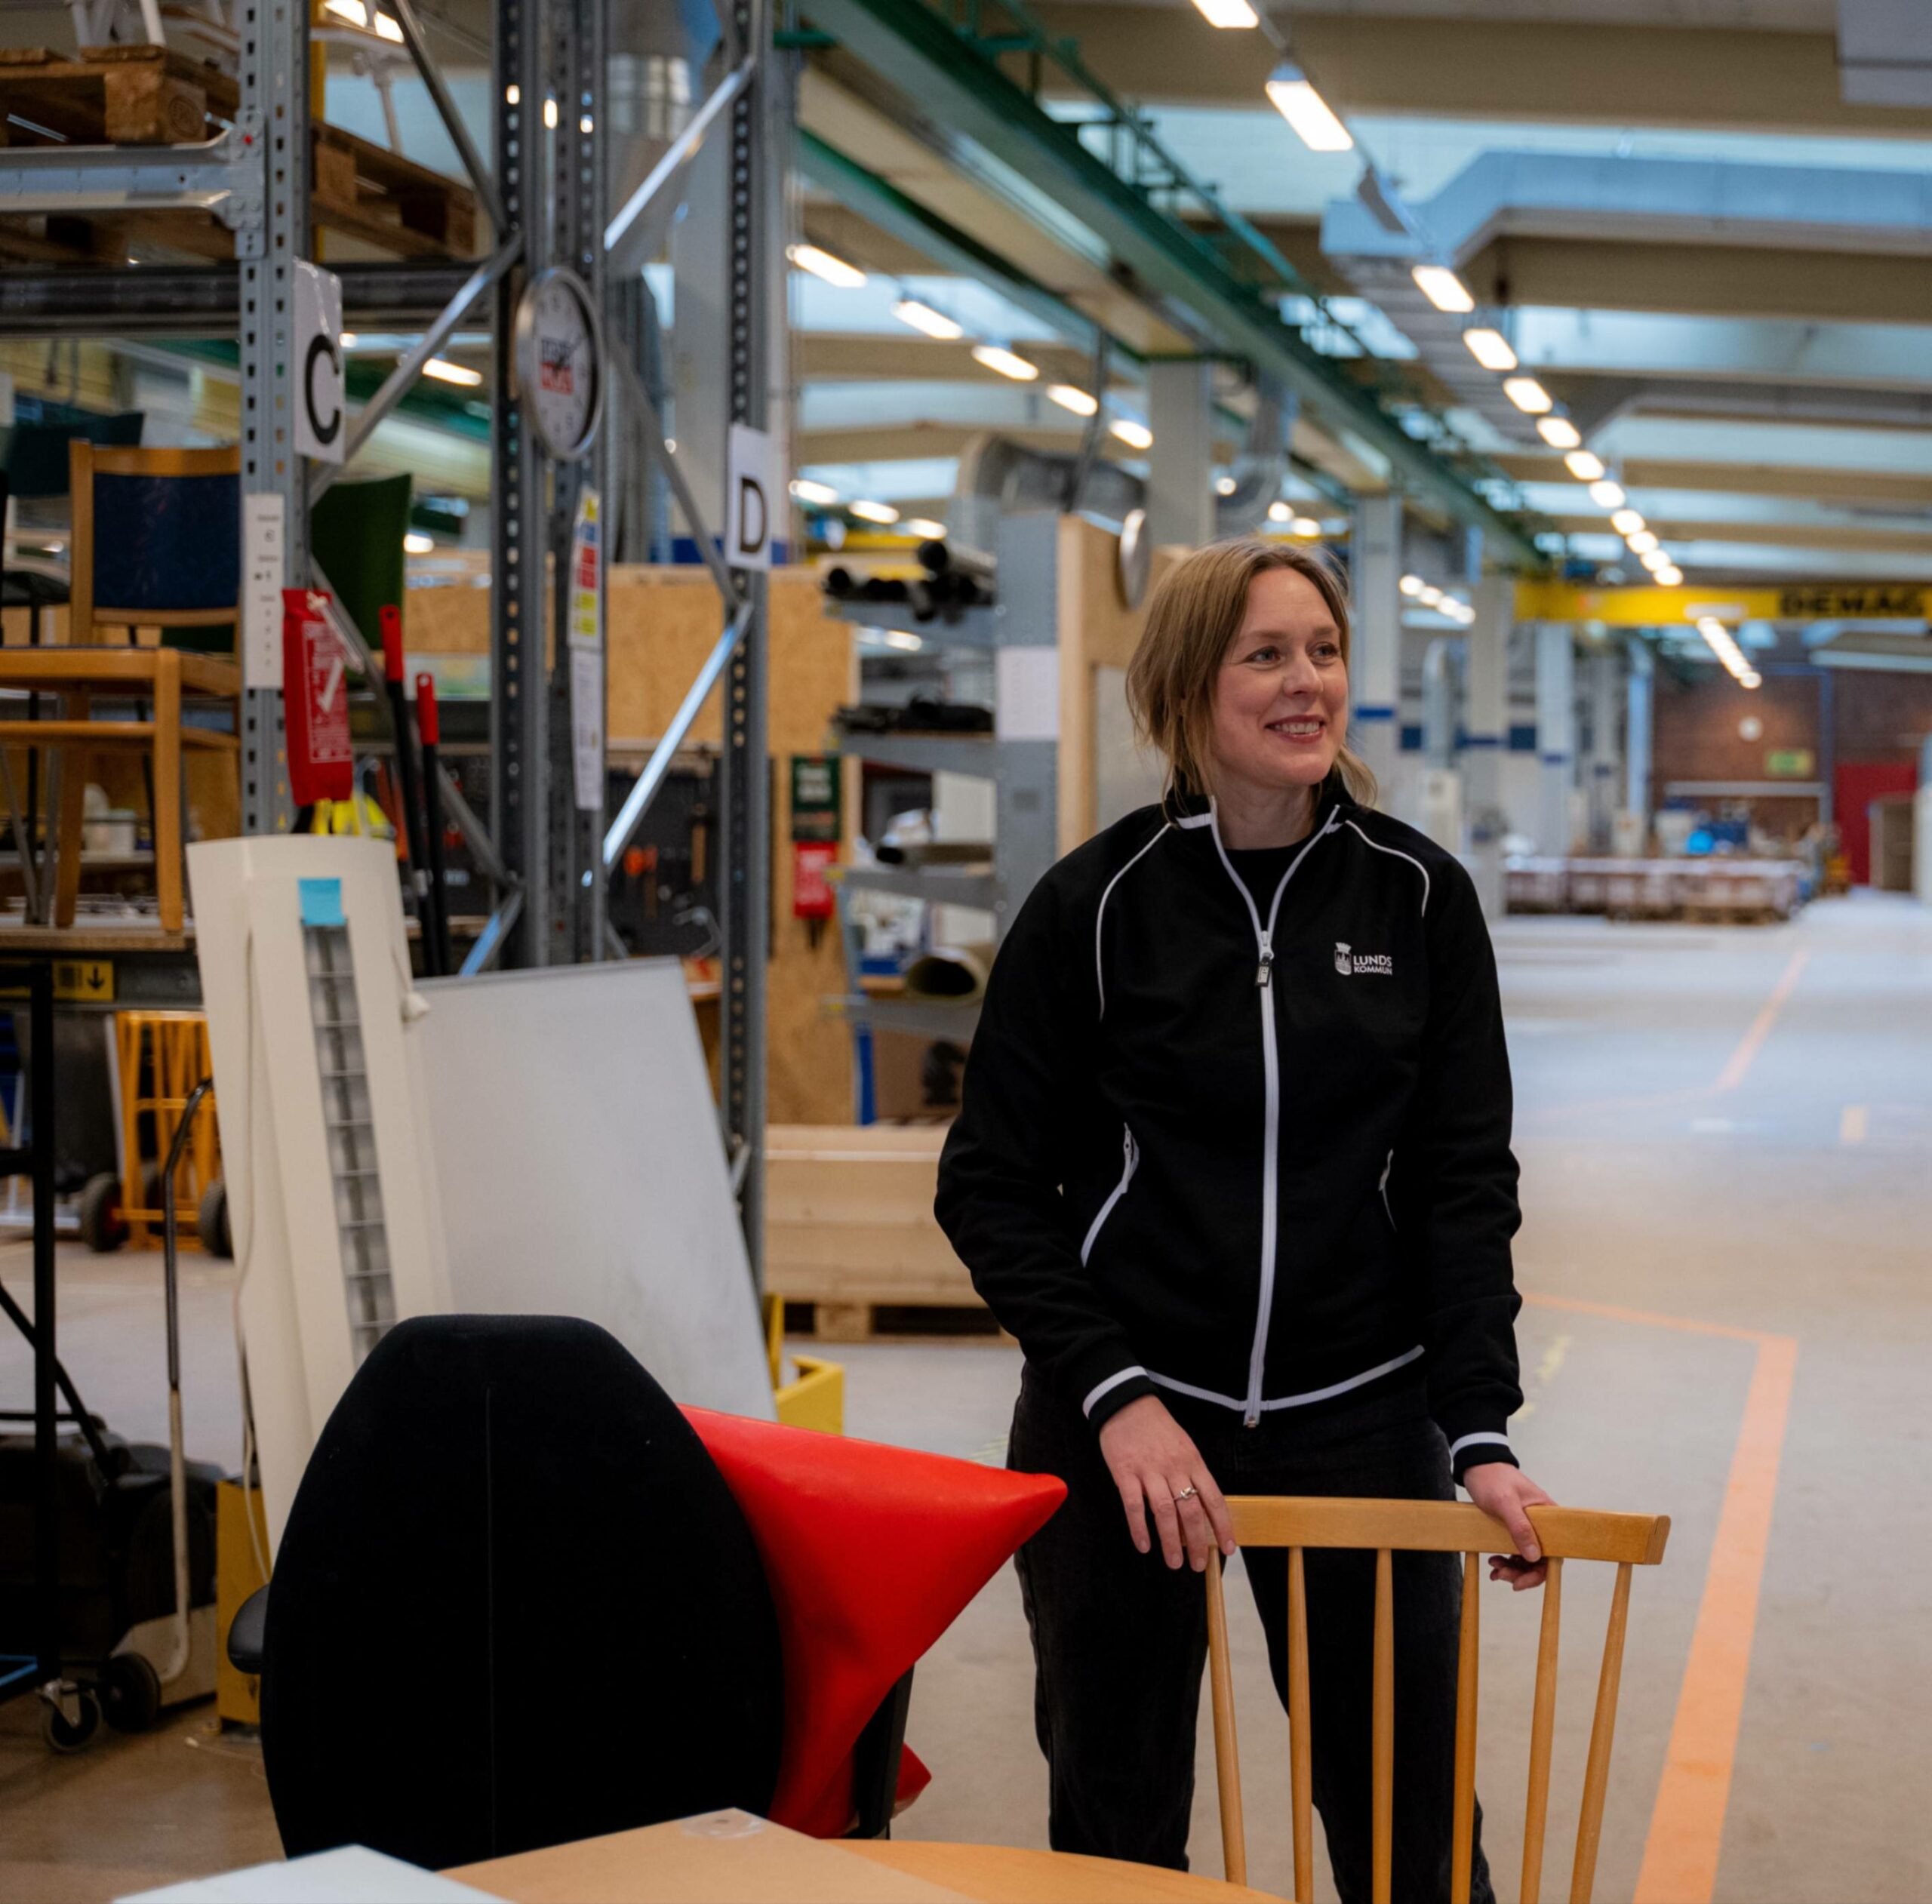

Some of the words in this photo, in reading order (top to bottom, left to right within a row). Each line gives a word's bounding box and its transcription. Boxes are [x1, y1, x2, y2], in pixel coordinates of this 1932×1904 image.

[305, 334, 341, 444] C
[740, 476, 768, 554] D
[1353, 955, 1392, 967] LUNDS
